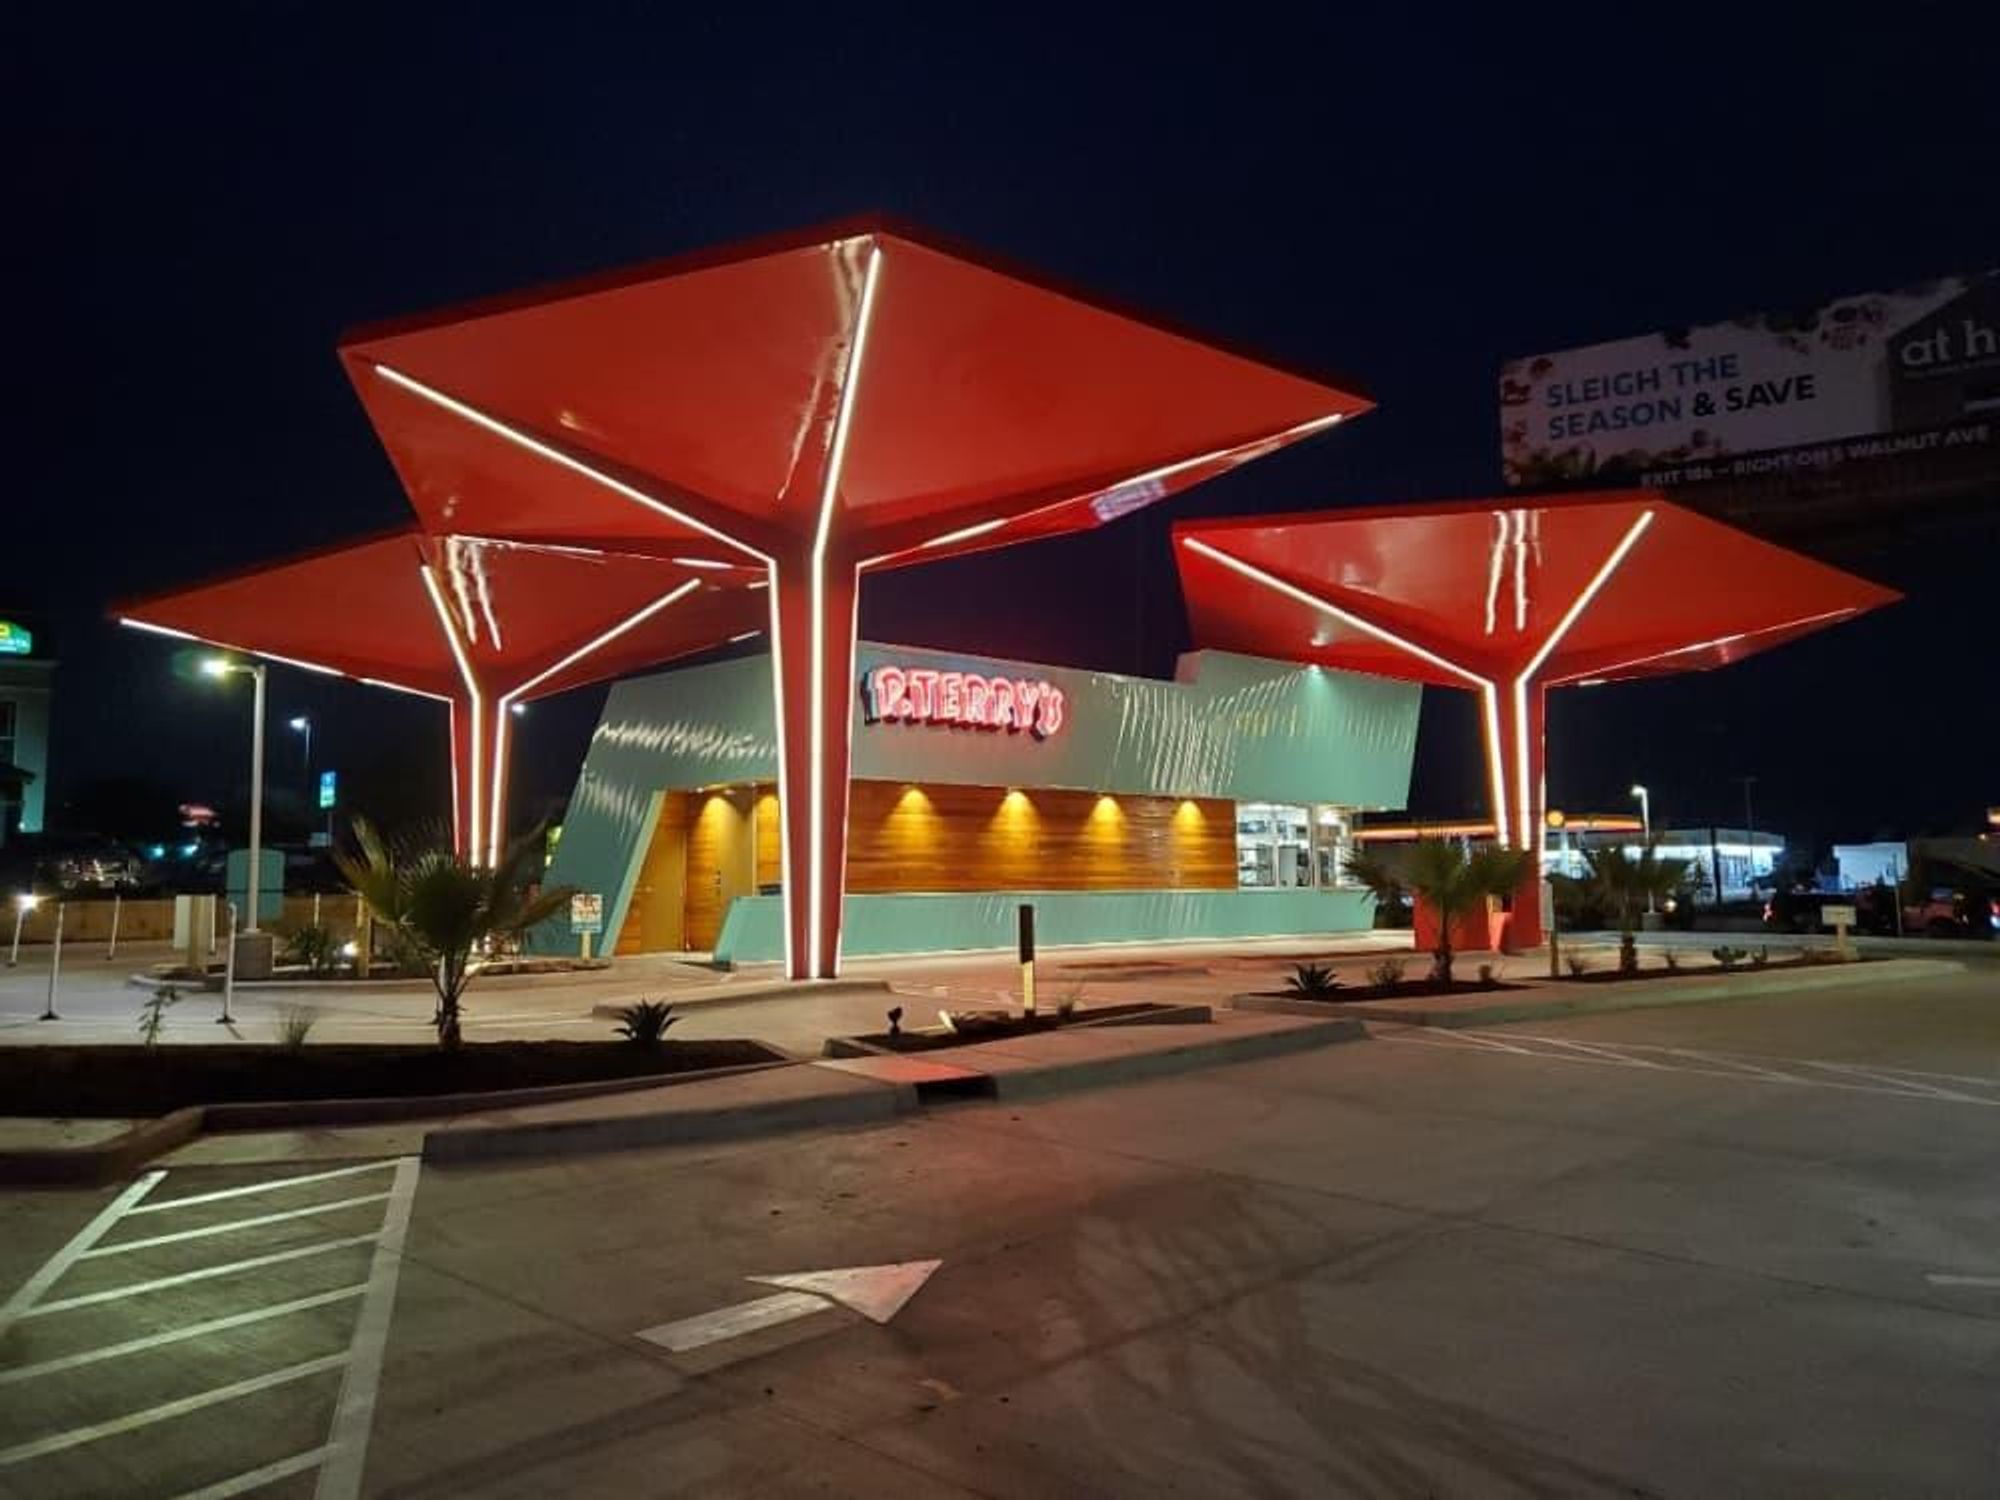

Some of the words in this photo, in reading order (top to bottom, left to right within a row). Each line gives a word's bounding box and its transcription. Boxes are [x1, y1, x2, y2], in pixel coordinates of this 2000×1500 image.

[1901, 328, 1951, 365] at
[1962, 319, 2000, 358] h
[1546, 367, 1660, 409] SLEIGH
[1669, 353, 1740, 386] THE
[1548, 398, 1681, 440] SEASON
[1693, 391, 1716, 417] &
[1725, 373, 1817, 412] SAVE
[1848, 432, 1941, 458] WALNUT
[1945, 423, 1989, 446] AVE
